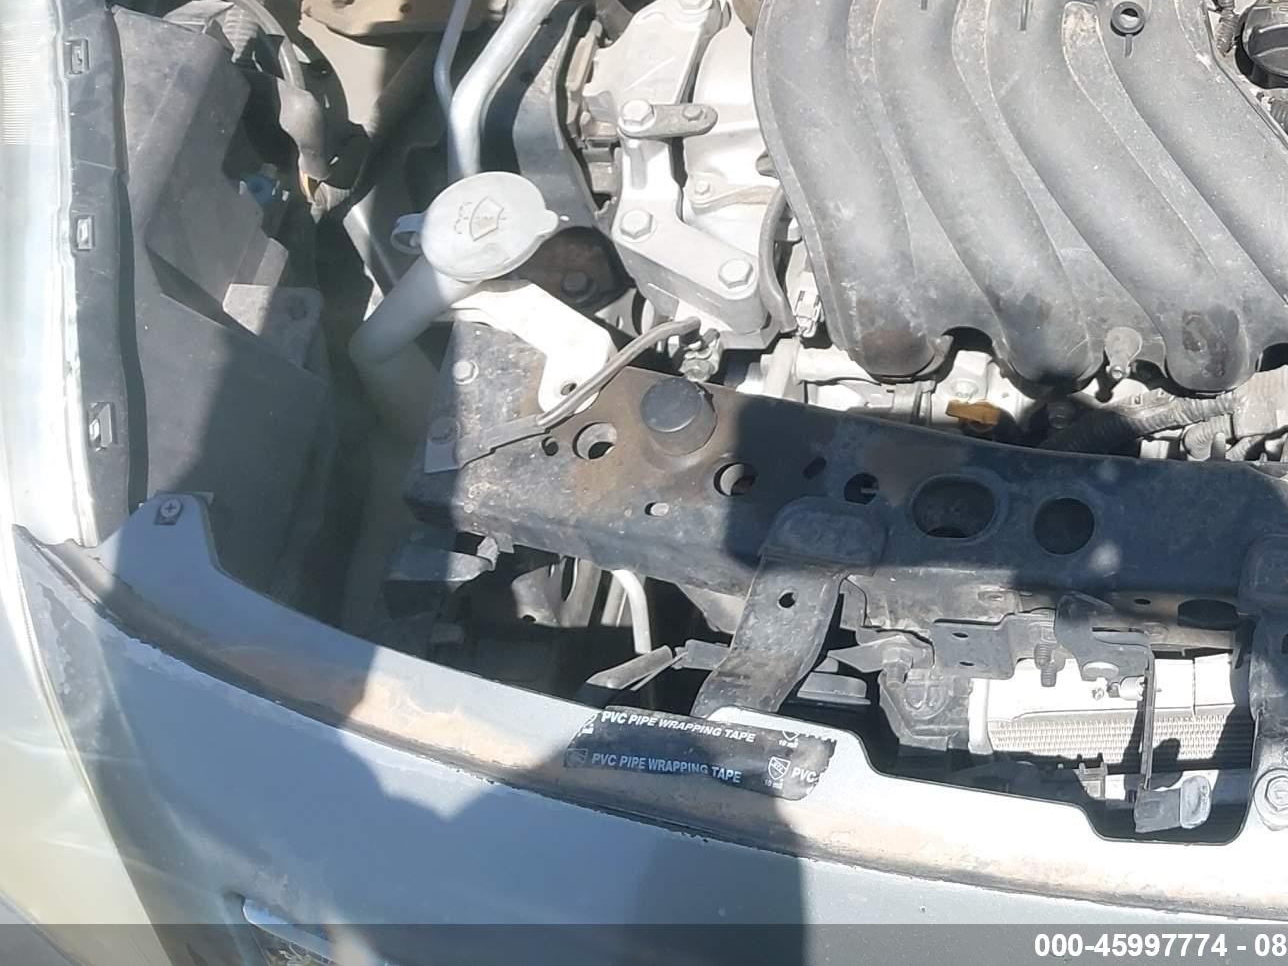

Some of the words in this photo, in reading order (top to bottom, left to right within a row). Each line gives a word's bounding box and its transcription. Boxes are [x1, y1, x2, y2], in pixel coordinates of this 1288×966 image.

[601, 711, 628, 726] PVC
[628, 713, 657, 728] PIPE
[657, 719, 722, 738] WRAPPING
[722, 728, 757, 744] TAPE
[591, 752, 617, 767] PVC
[618, 754, 647, 771] PIPE
[647, 757, 709, 776] WRAPPING
[710, 764, 743, 784] TAPE
